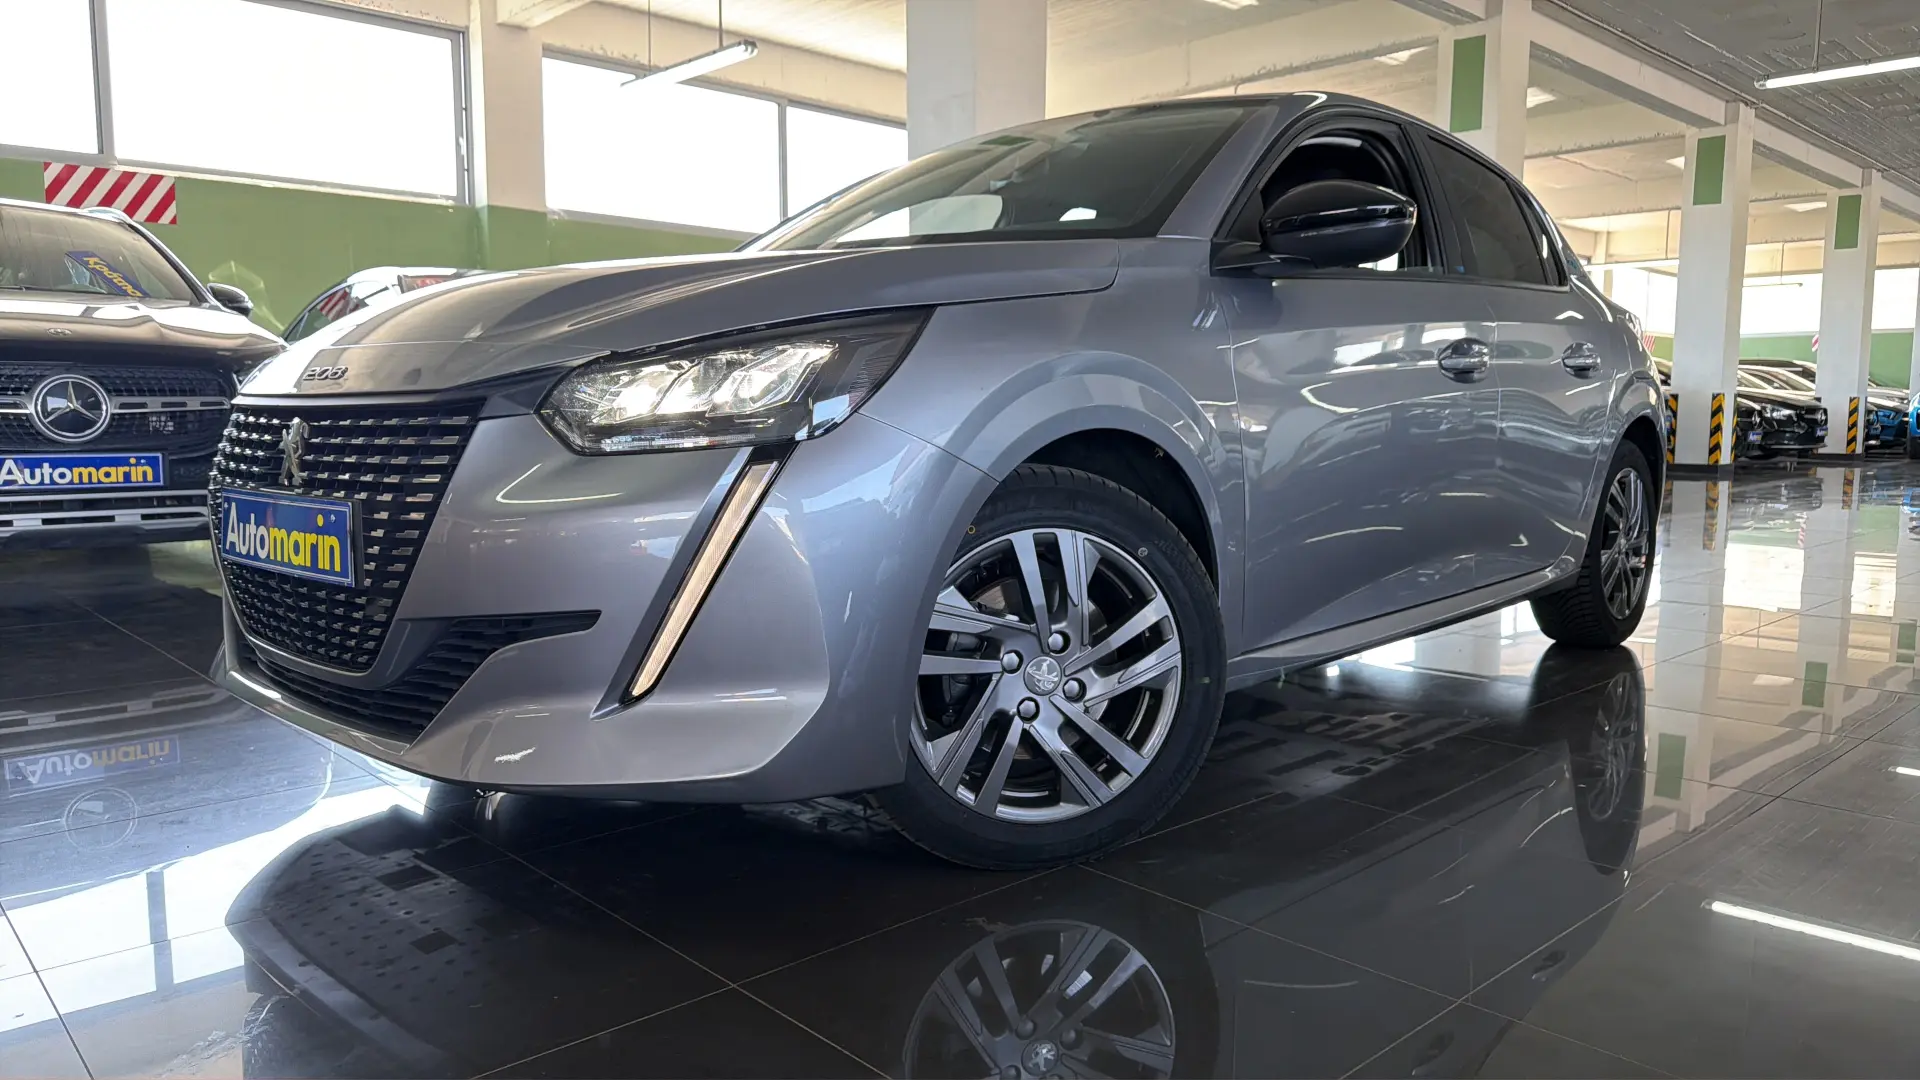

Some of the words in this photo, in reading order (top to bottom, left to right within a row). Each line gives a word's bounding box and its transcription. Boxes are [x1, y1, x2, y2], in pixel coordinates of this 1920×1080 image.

[303, 366, 349, 381] 208
[0, 457, 153, 485] Automarin
[226, 502, 341, 572] Automarin
